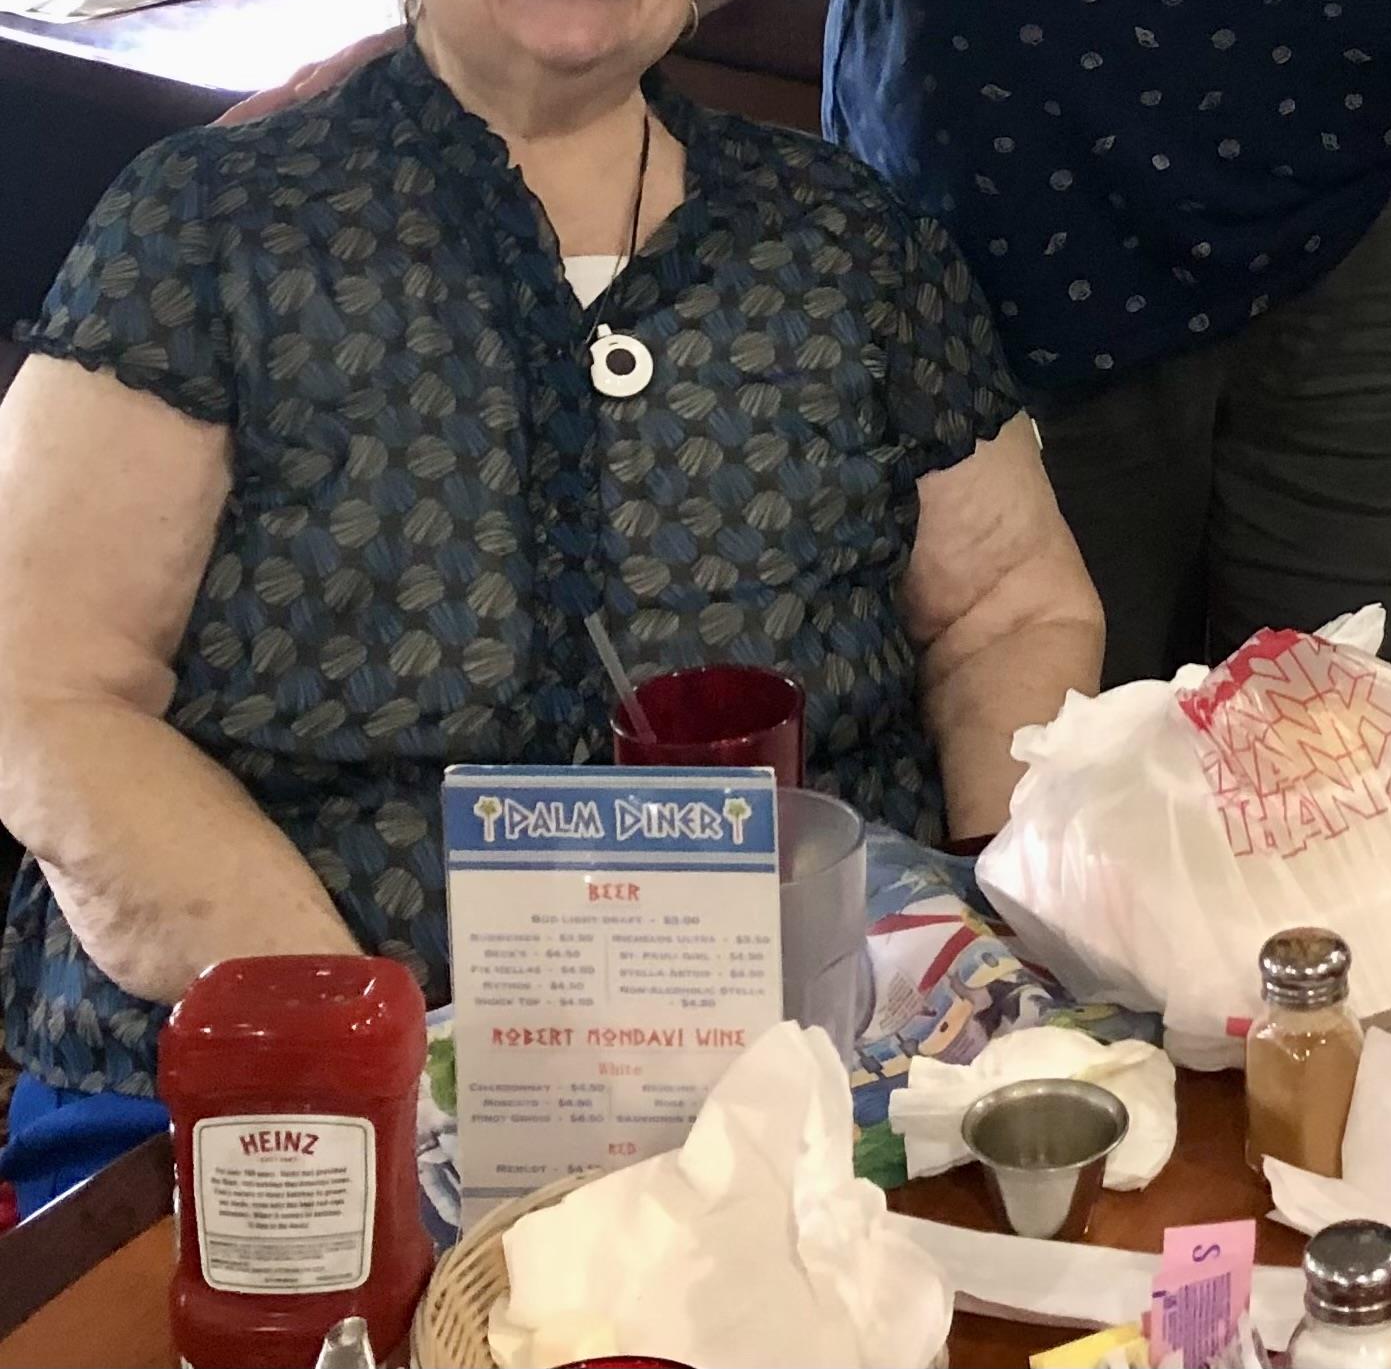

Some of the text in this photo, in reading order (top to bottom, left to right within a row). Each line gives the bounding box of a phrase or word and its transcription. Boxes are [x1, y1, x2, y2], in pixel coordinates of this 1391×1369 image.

[505, 798, 723, 841] PALM DINER
[589, 883, 640, 901] BEER
[491, 1027, 746, 1048] ROBERT MONDAVI WINE
[239, 1130, 320, 1156] HEINZ
[608, 1143, 637, 1155] RED
